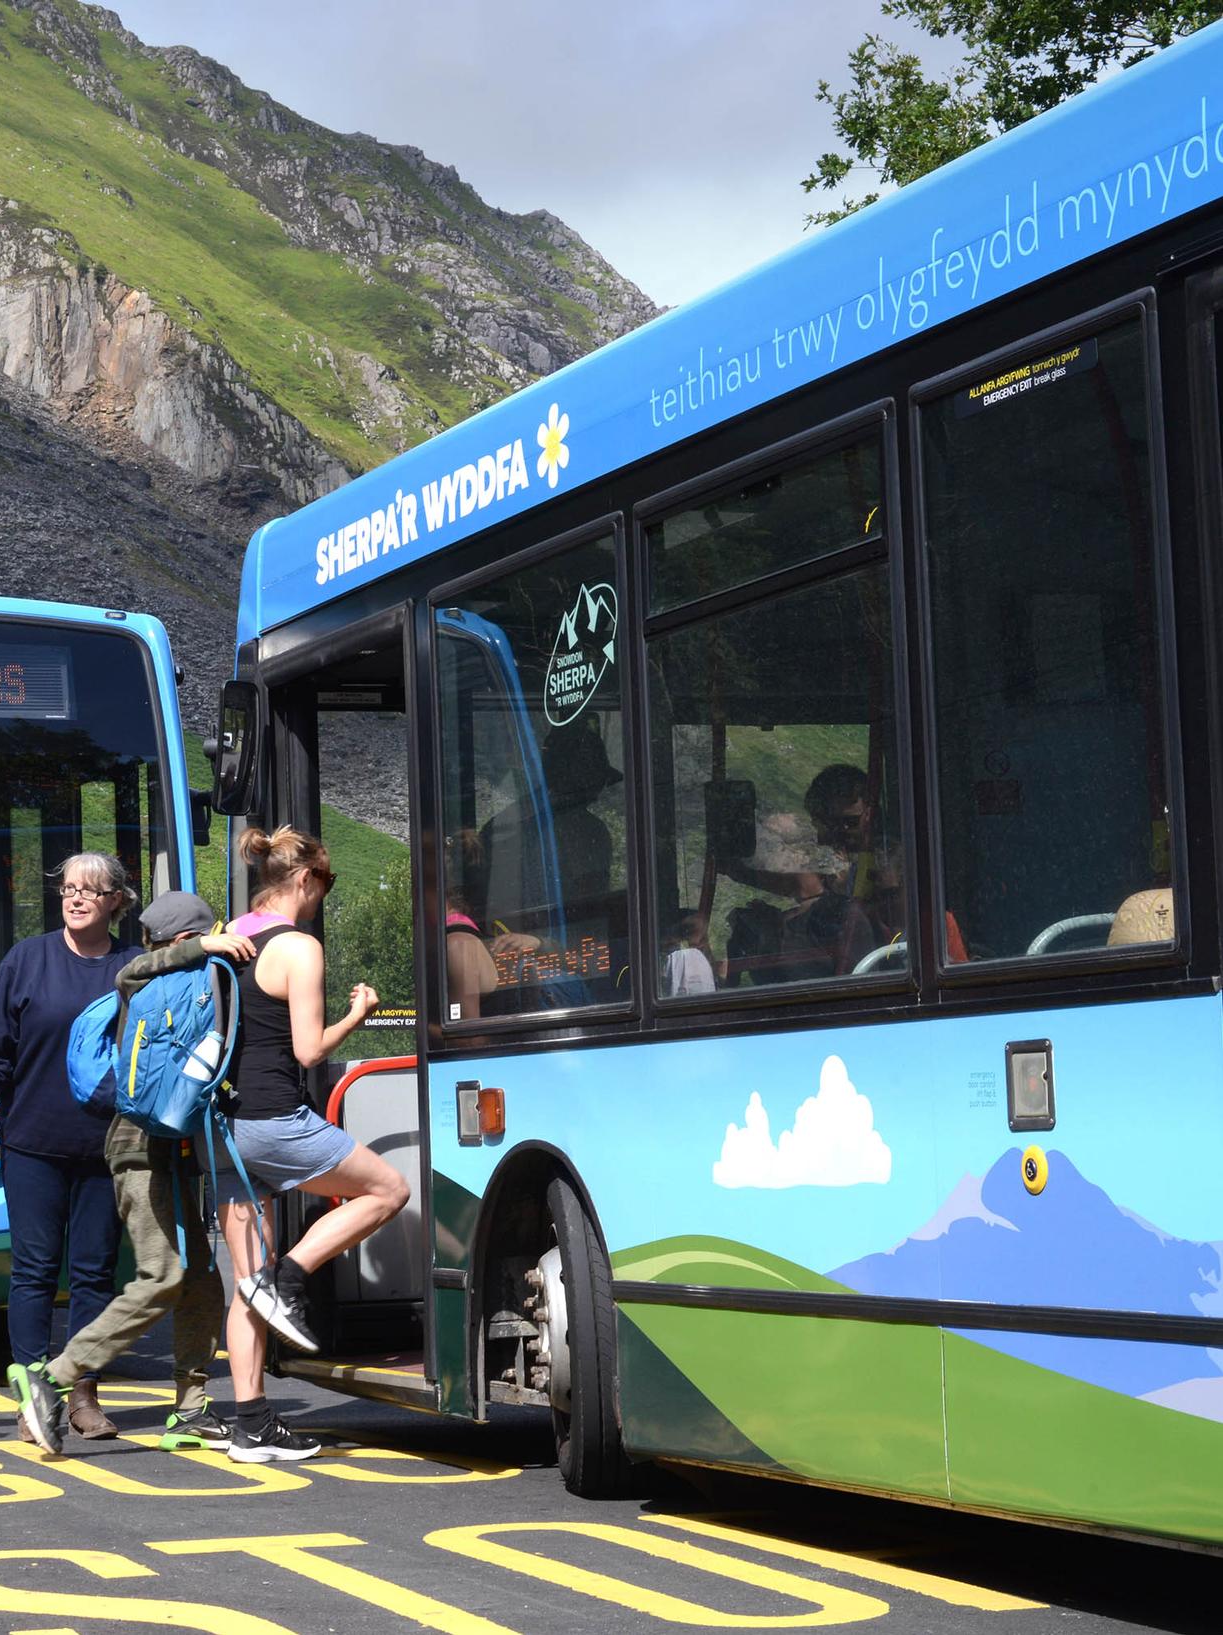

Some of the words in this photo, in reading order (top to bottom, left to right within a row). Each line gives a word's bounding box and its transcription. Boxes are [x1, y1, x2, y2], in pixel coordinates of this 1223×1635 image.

[650, 346, 762, 427] teithiau
[772, 306, 843, 370] trwy
[856, 181, 1040, 335] olygfeydd
[968, 381, 997, 400] ALLANFA
[995, 366, 1031, 388] ARGYFWNG
[1061, 347, 1081, 365] gwydr
[983, 383, 1020, 407] EMERGENCY
[1019, 378, 1032, 393] EXIT
[1033, 373, 1051, 387] break
[1051, 366, 1067, 383] glass
[315, 489, 419, 585] SHERPA'R
[422, 438, 530, 533] WYDDFA
[557, 651, 583, 669] SNOWDON
[550, 662, 596, 696] SHERPA
[562, 690, 584, 706] WYDDFA
[365, 1018, 405, 1026] EMERGENCY
